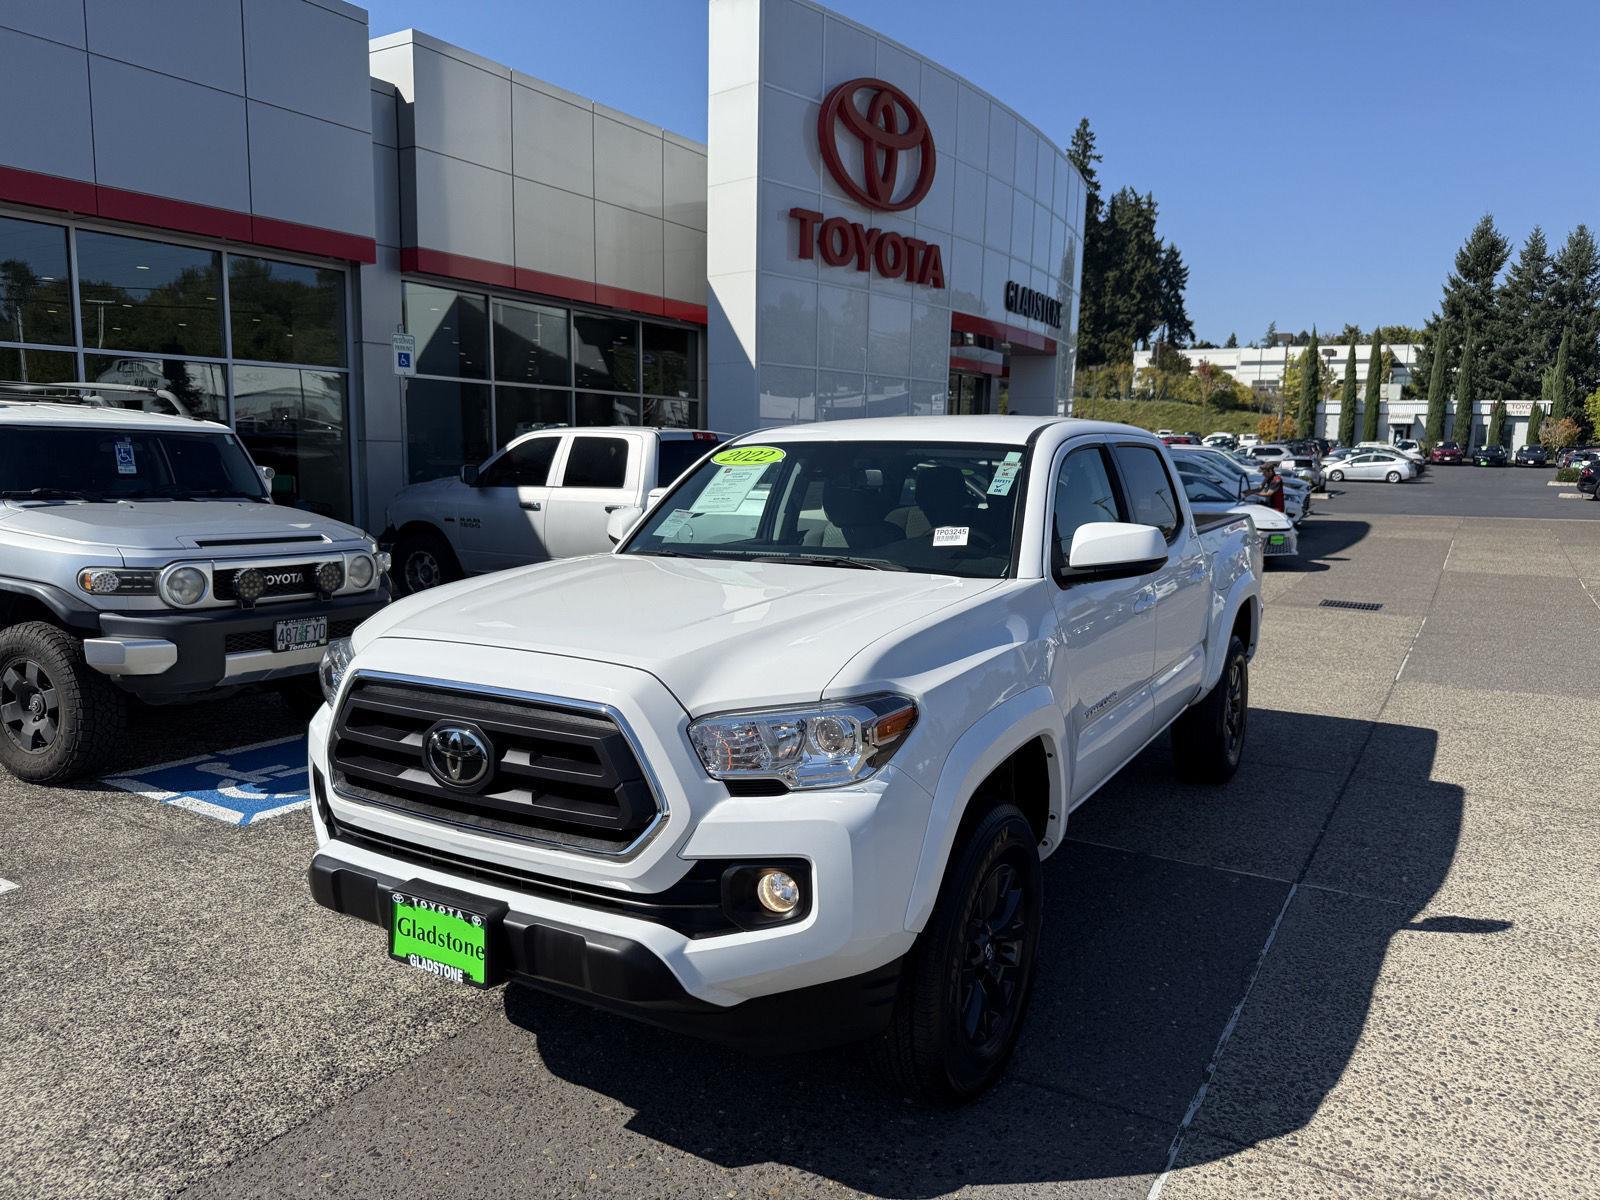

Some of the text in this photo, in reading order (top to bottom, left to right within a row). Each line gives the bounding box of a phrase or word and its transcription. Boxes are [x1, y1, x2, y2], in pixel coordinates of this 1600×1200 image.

[789, 207, 945, 289] TOYOTA
[1005, 280, 1063, 329] GLADSTONE
[720, 450, 776, 462] 2022
[936, 528, 967, 536] TP03245
[264, 573, 304, 585] OYOTA
[278, 626, 298, 644] 487
[288, 641, 317, 651] Tonkin
[411, 897, 465, 920] TOYOTA
[397, 917, 485, 961] Gladstone
[409, 953, 464, 983] GLADSTONE
